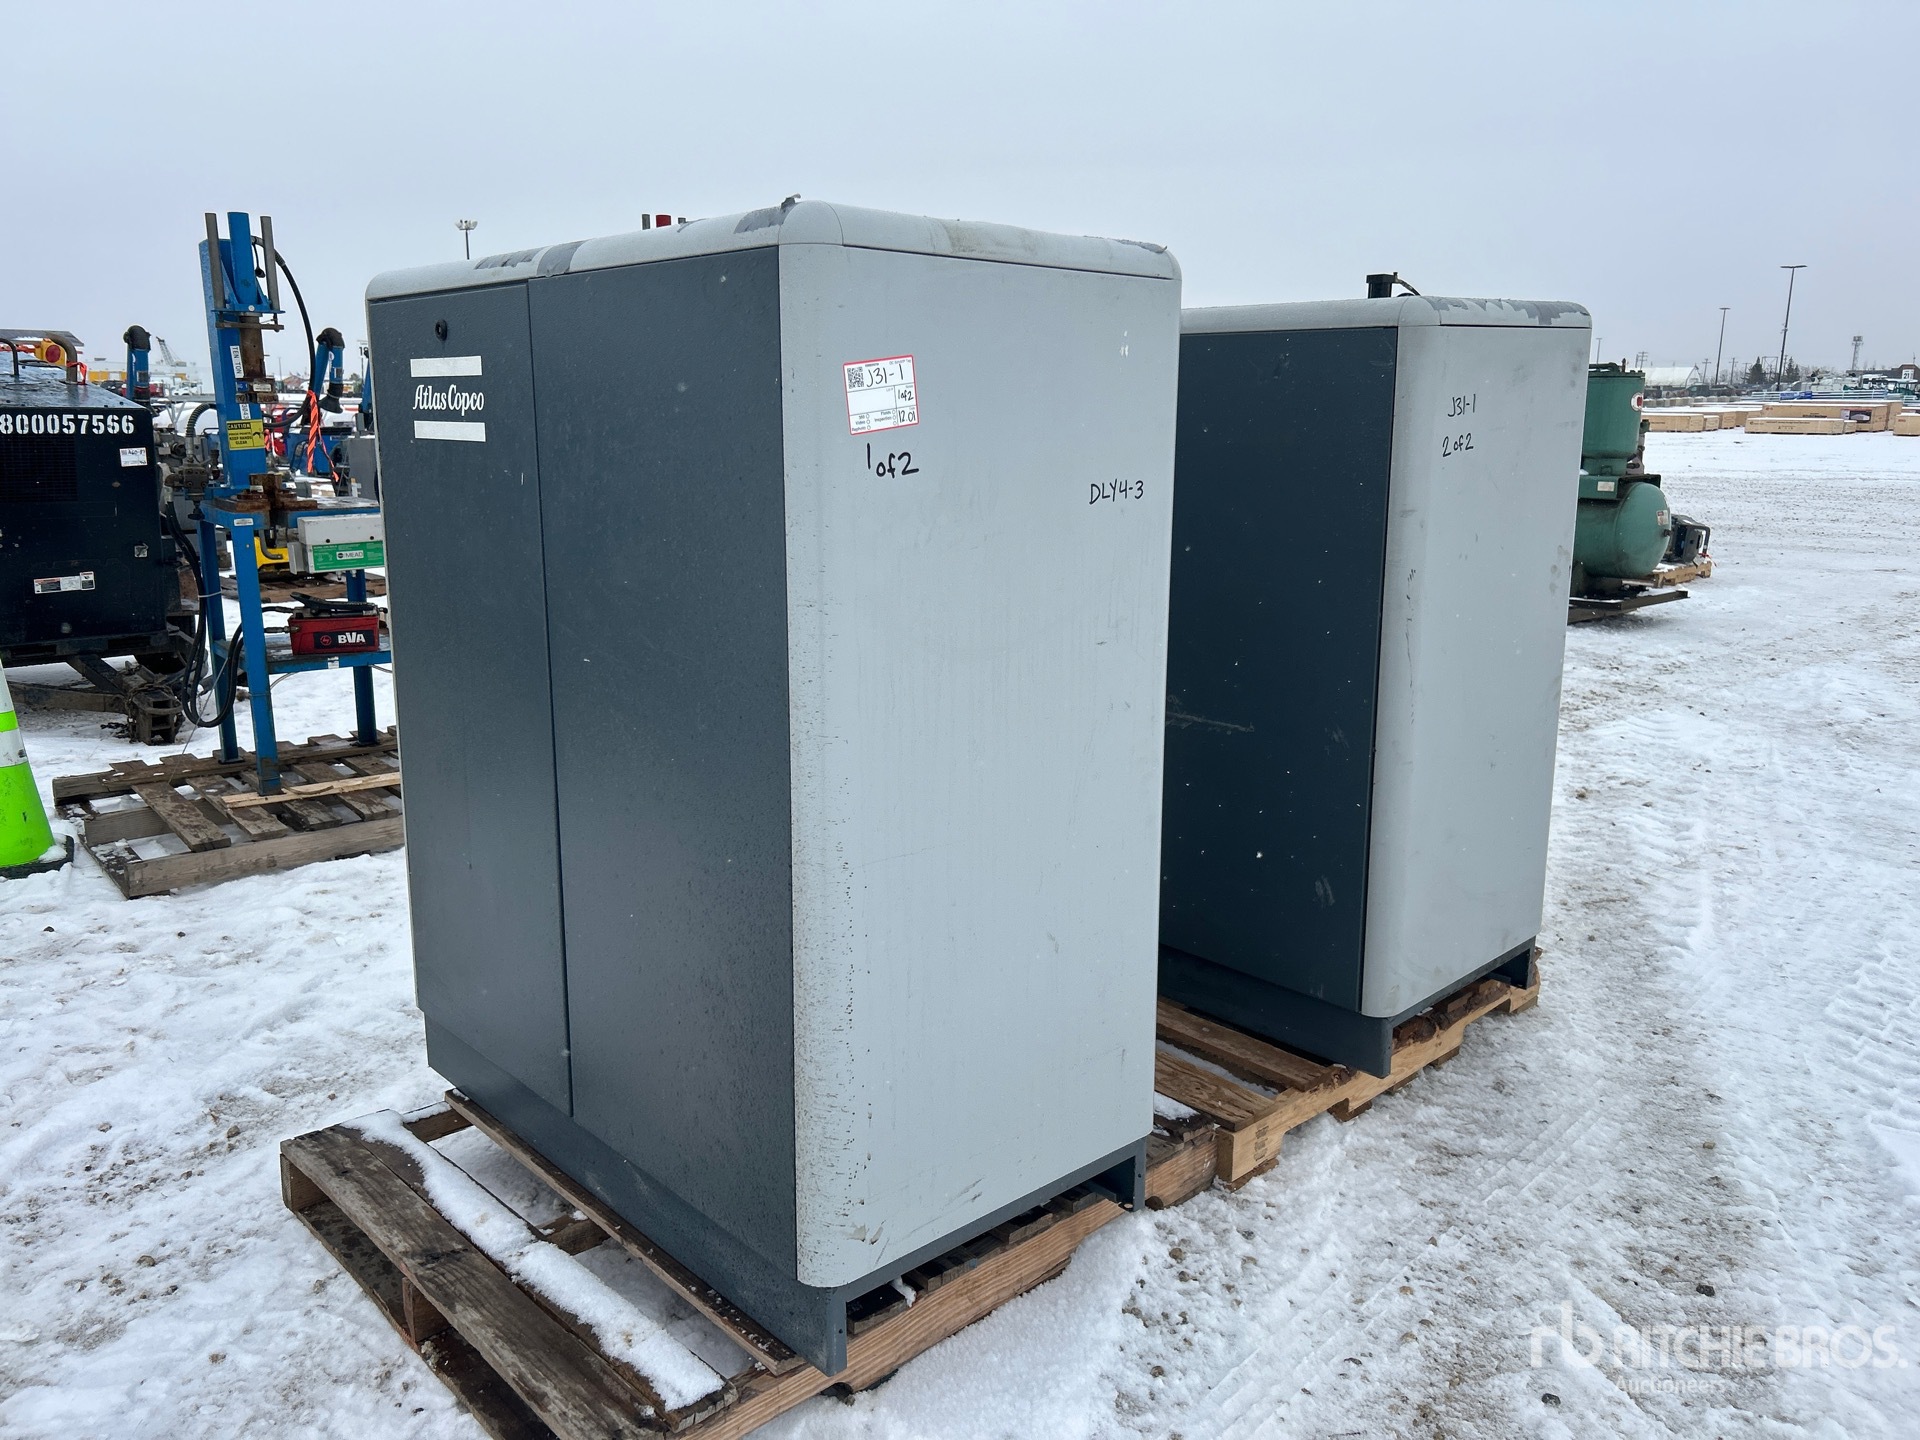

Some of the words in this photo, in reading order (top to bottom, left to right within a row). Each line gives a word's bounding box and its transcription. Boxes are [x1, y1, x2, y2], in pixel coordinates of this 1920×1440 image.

[867, 364, 903, 387] J31-1
[1448, 394, 1476, 417] J31-1
[0, 414, 135, 434] 800057566
[1089, 478, 1144, 505] DLY4-3
[337, 632, 366, 644] BVA
